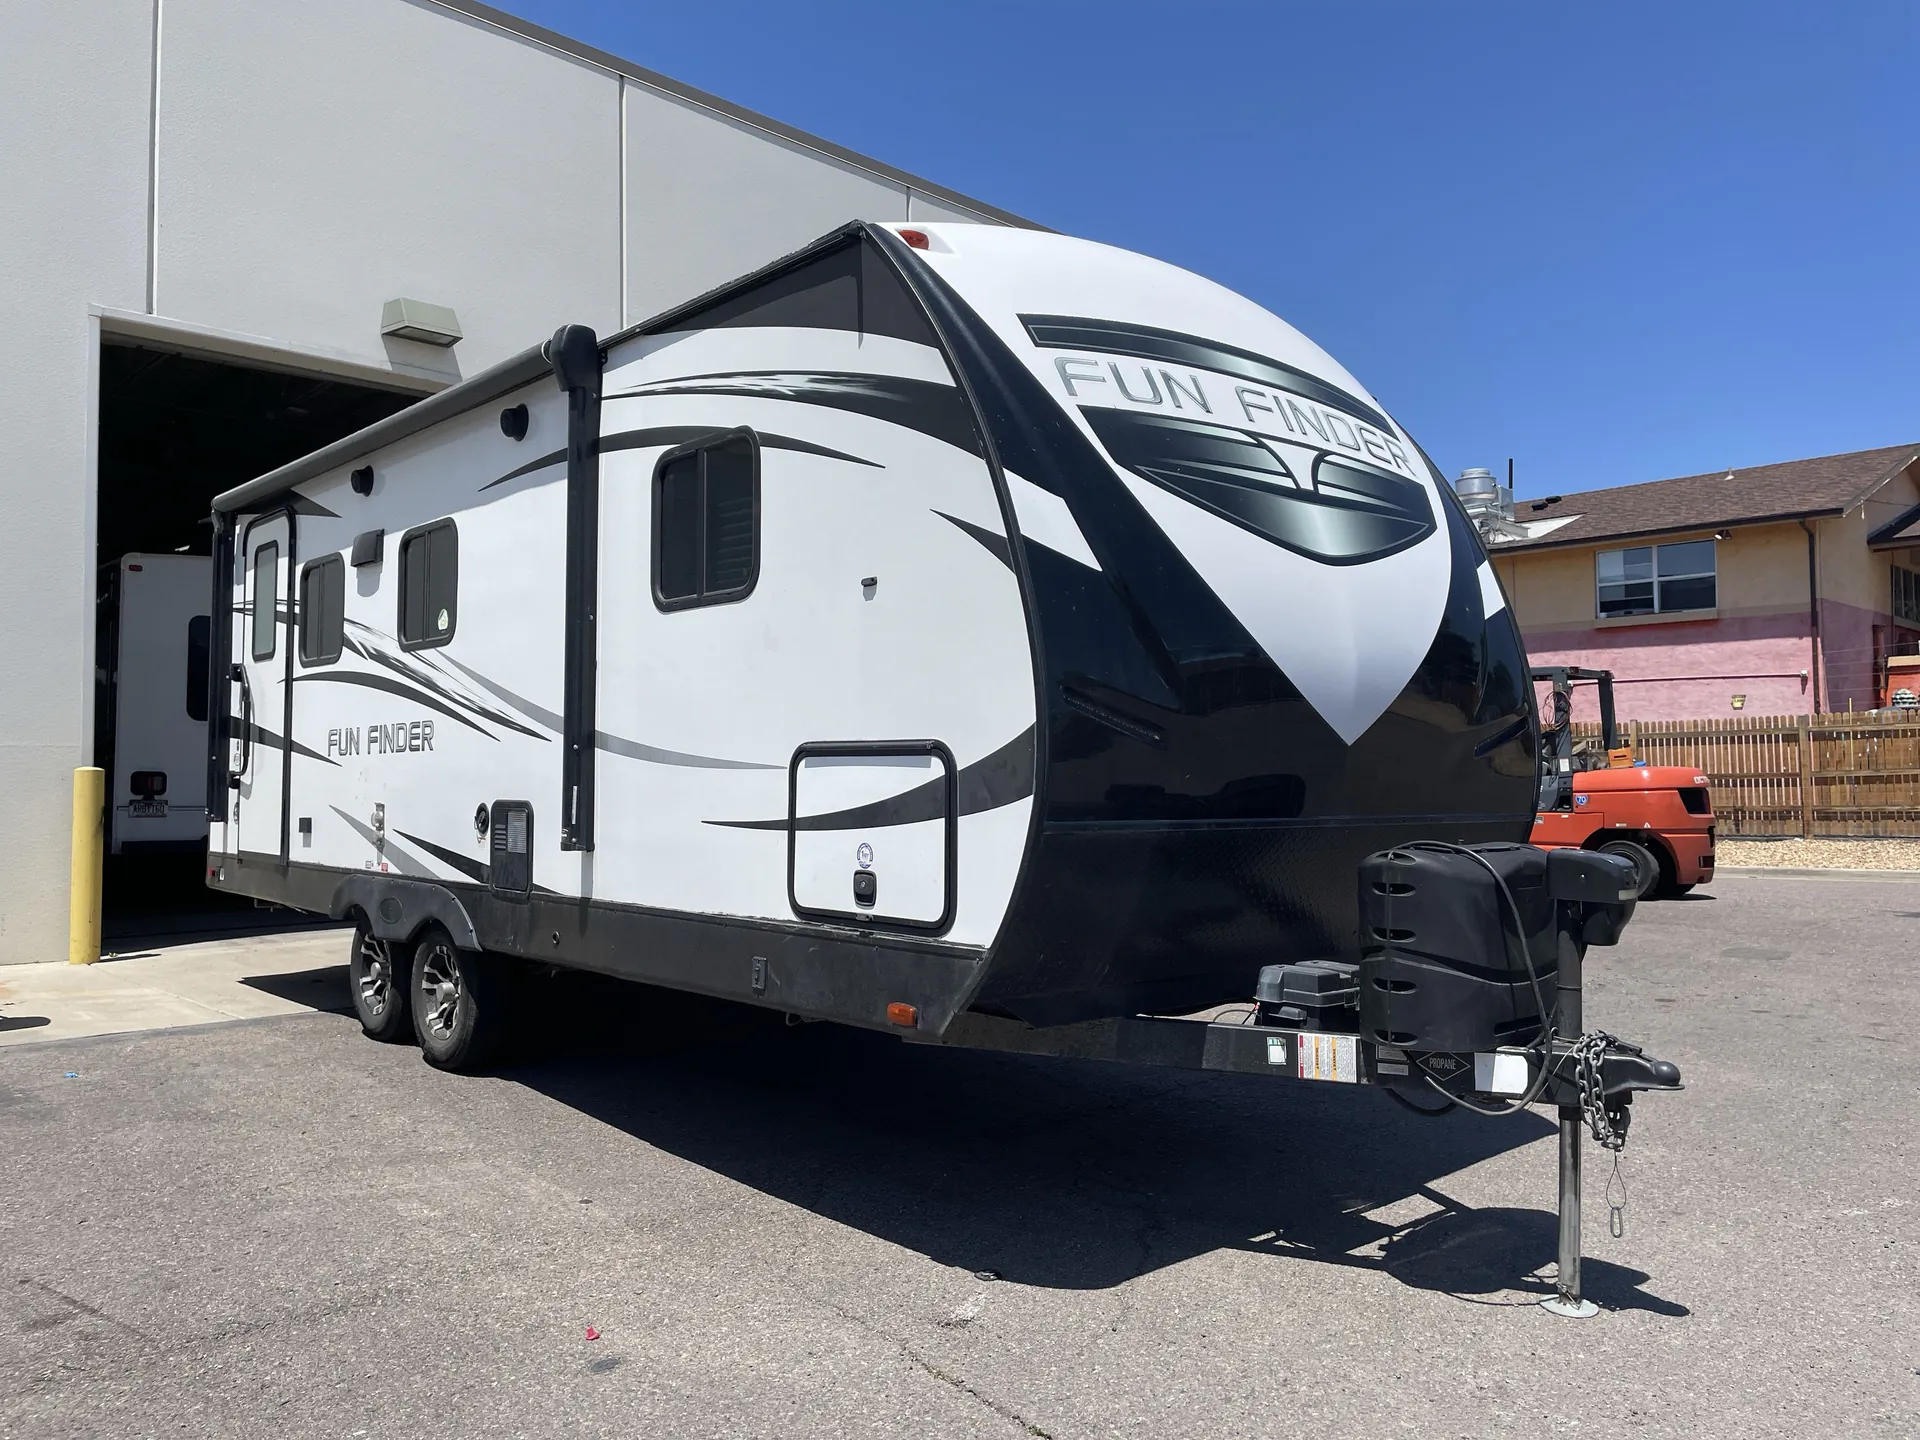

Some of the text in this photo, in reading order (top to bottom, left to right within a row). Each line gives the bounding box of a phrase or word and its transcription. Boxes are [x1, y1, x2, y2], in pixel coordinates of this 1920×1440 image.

[1053, 356, 1417, 477] FUN FINDER
[327, 719, 435, 757] FUN FINDER
[1429, 1057, 1457, 1070] PROPANE
